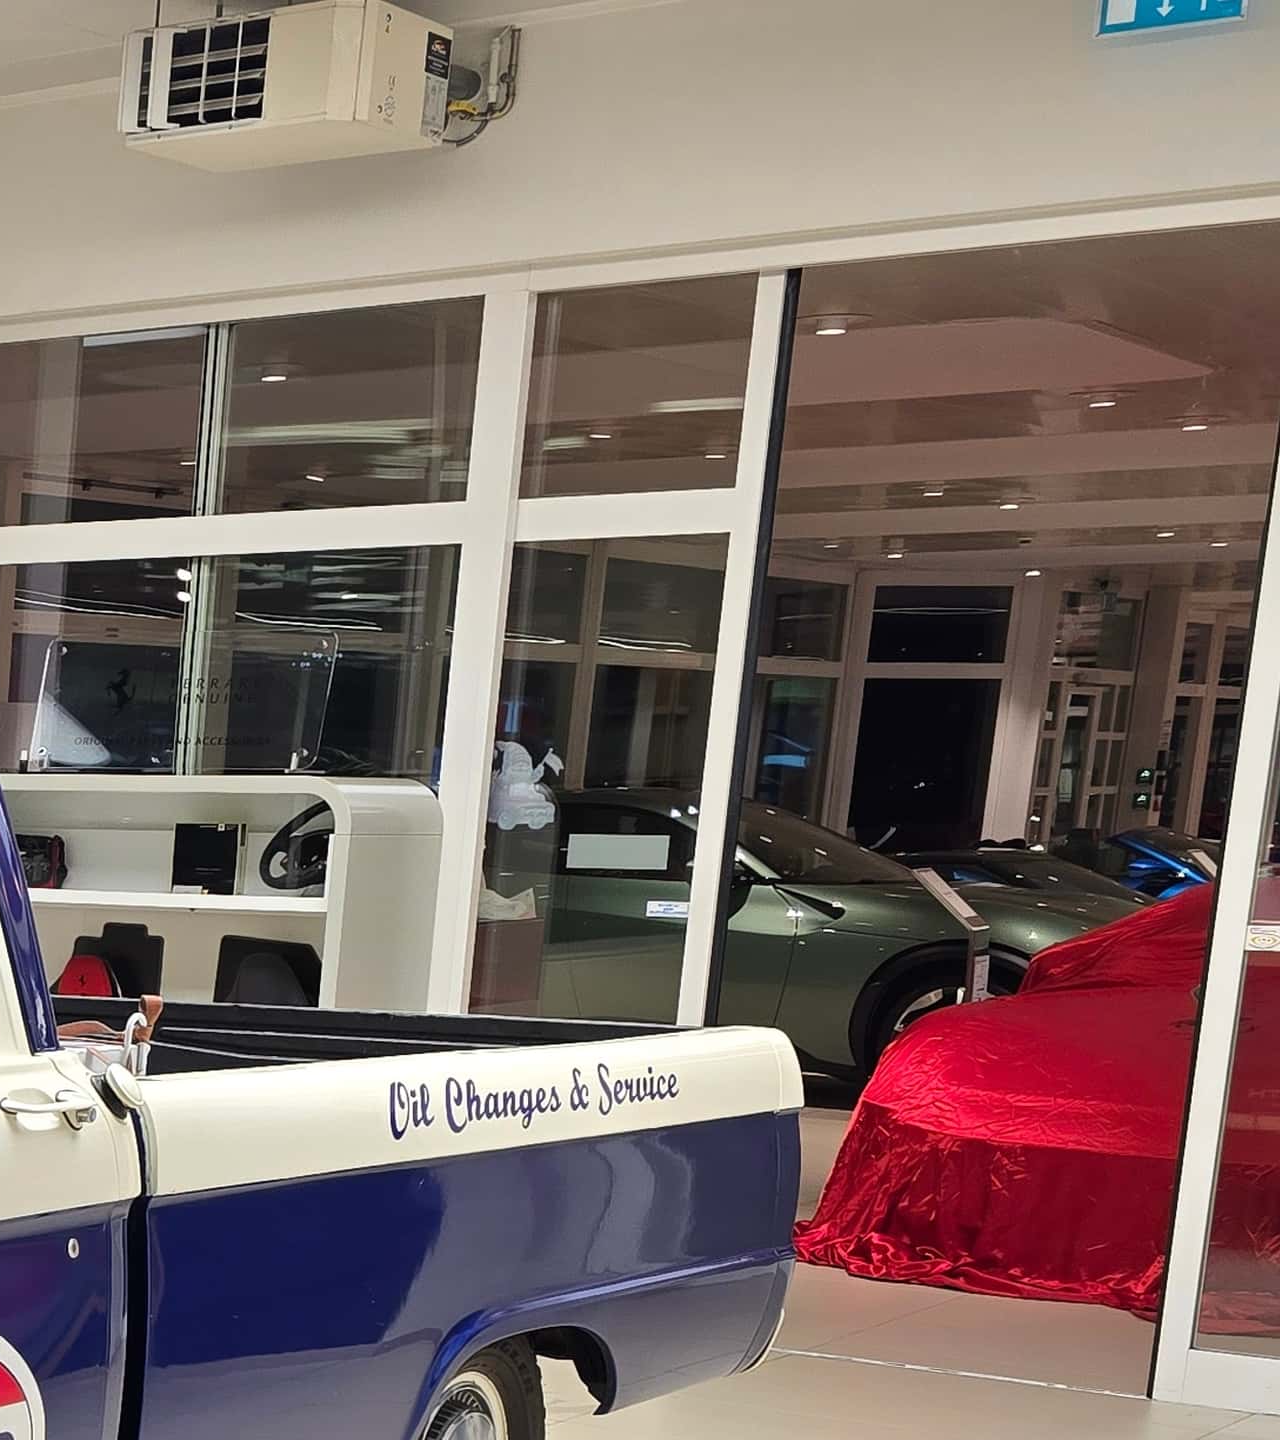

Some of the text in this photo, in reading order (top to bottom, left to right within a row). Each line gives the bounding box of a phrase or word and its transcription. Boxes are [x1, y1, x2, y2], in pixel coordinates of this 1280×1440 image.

[170, 678, 260, 689] ERRAR
[390, 1063, 680, 1140] Oil Changes & Service
